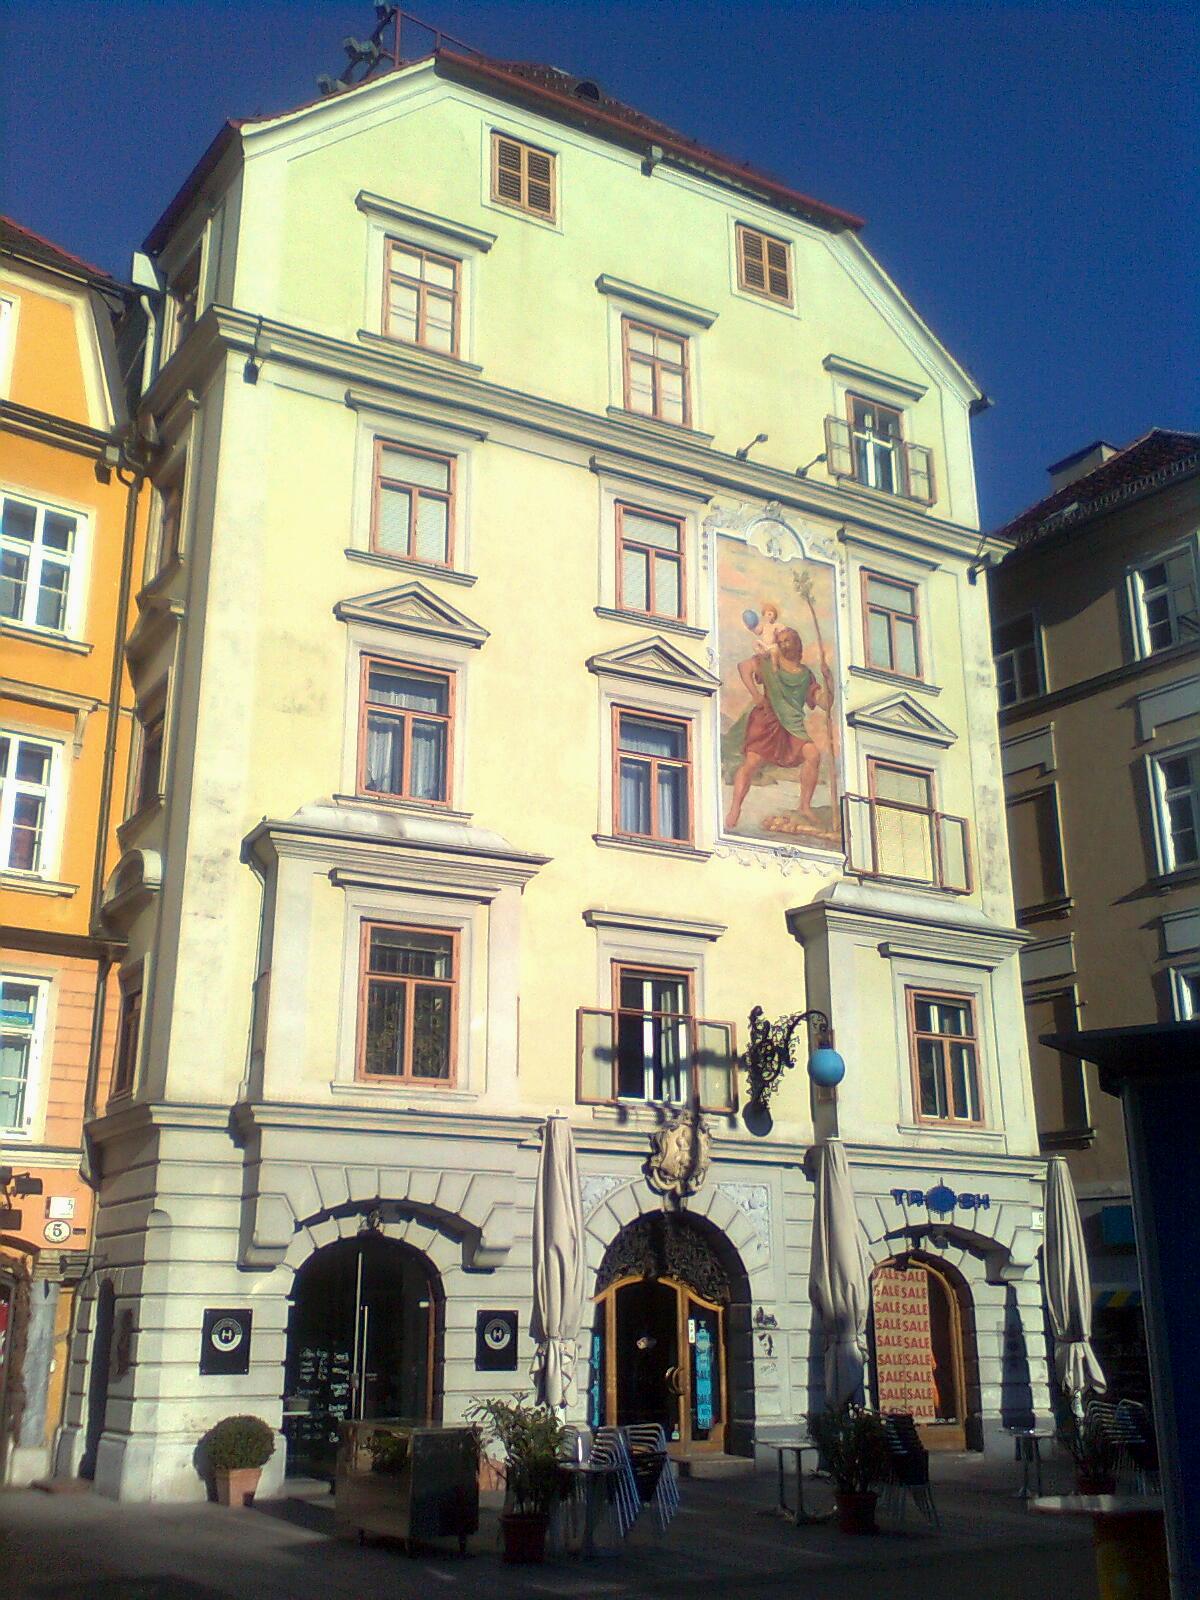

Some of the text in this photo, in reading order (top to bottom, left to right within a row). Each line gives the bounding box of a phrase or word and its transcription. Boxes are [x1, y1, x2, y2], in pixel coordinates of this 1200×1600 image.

[53, 1223, 62, 1237] 5
[900, 1271, 925, 1282] SALE
[901, 1287, 926, 1299] SALE
[875, 1302, 928, 1315] SALE SALE
[876, 1318, 928, 1332] SALE SALE
[221, 1330, 232, 1340] H
[877, 1335, 929, 1348] SALE SALE
[878, 1353, 931, 1365] SALE SALE
[879, 1371, 931, 1383] SALE SALE
[881, 1388, 933, 1400] SALE SALE
[908, 1405, 934, 1416] SALE
